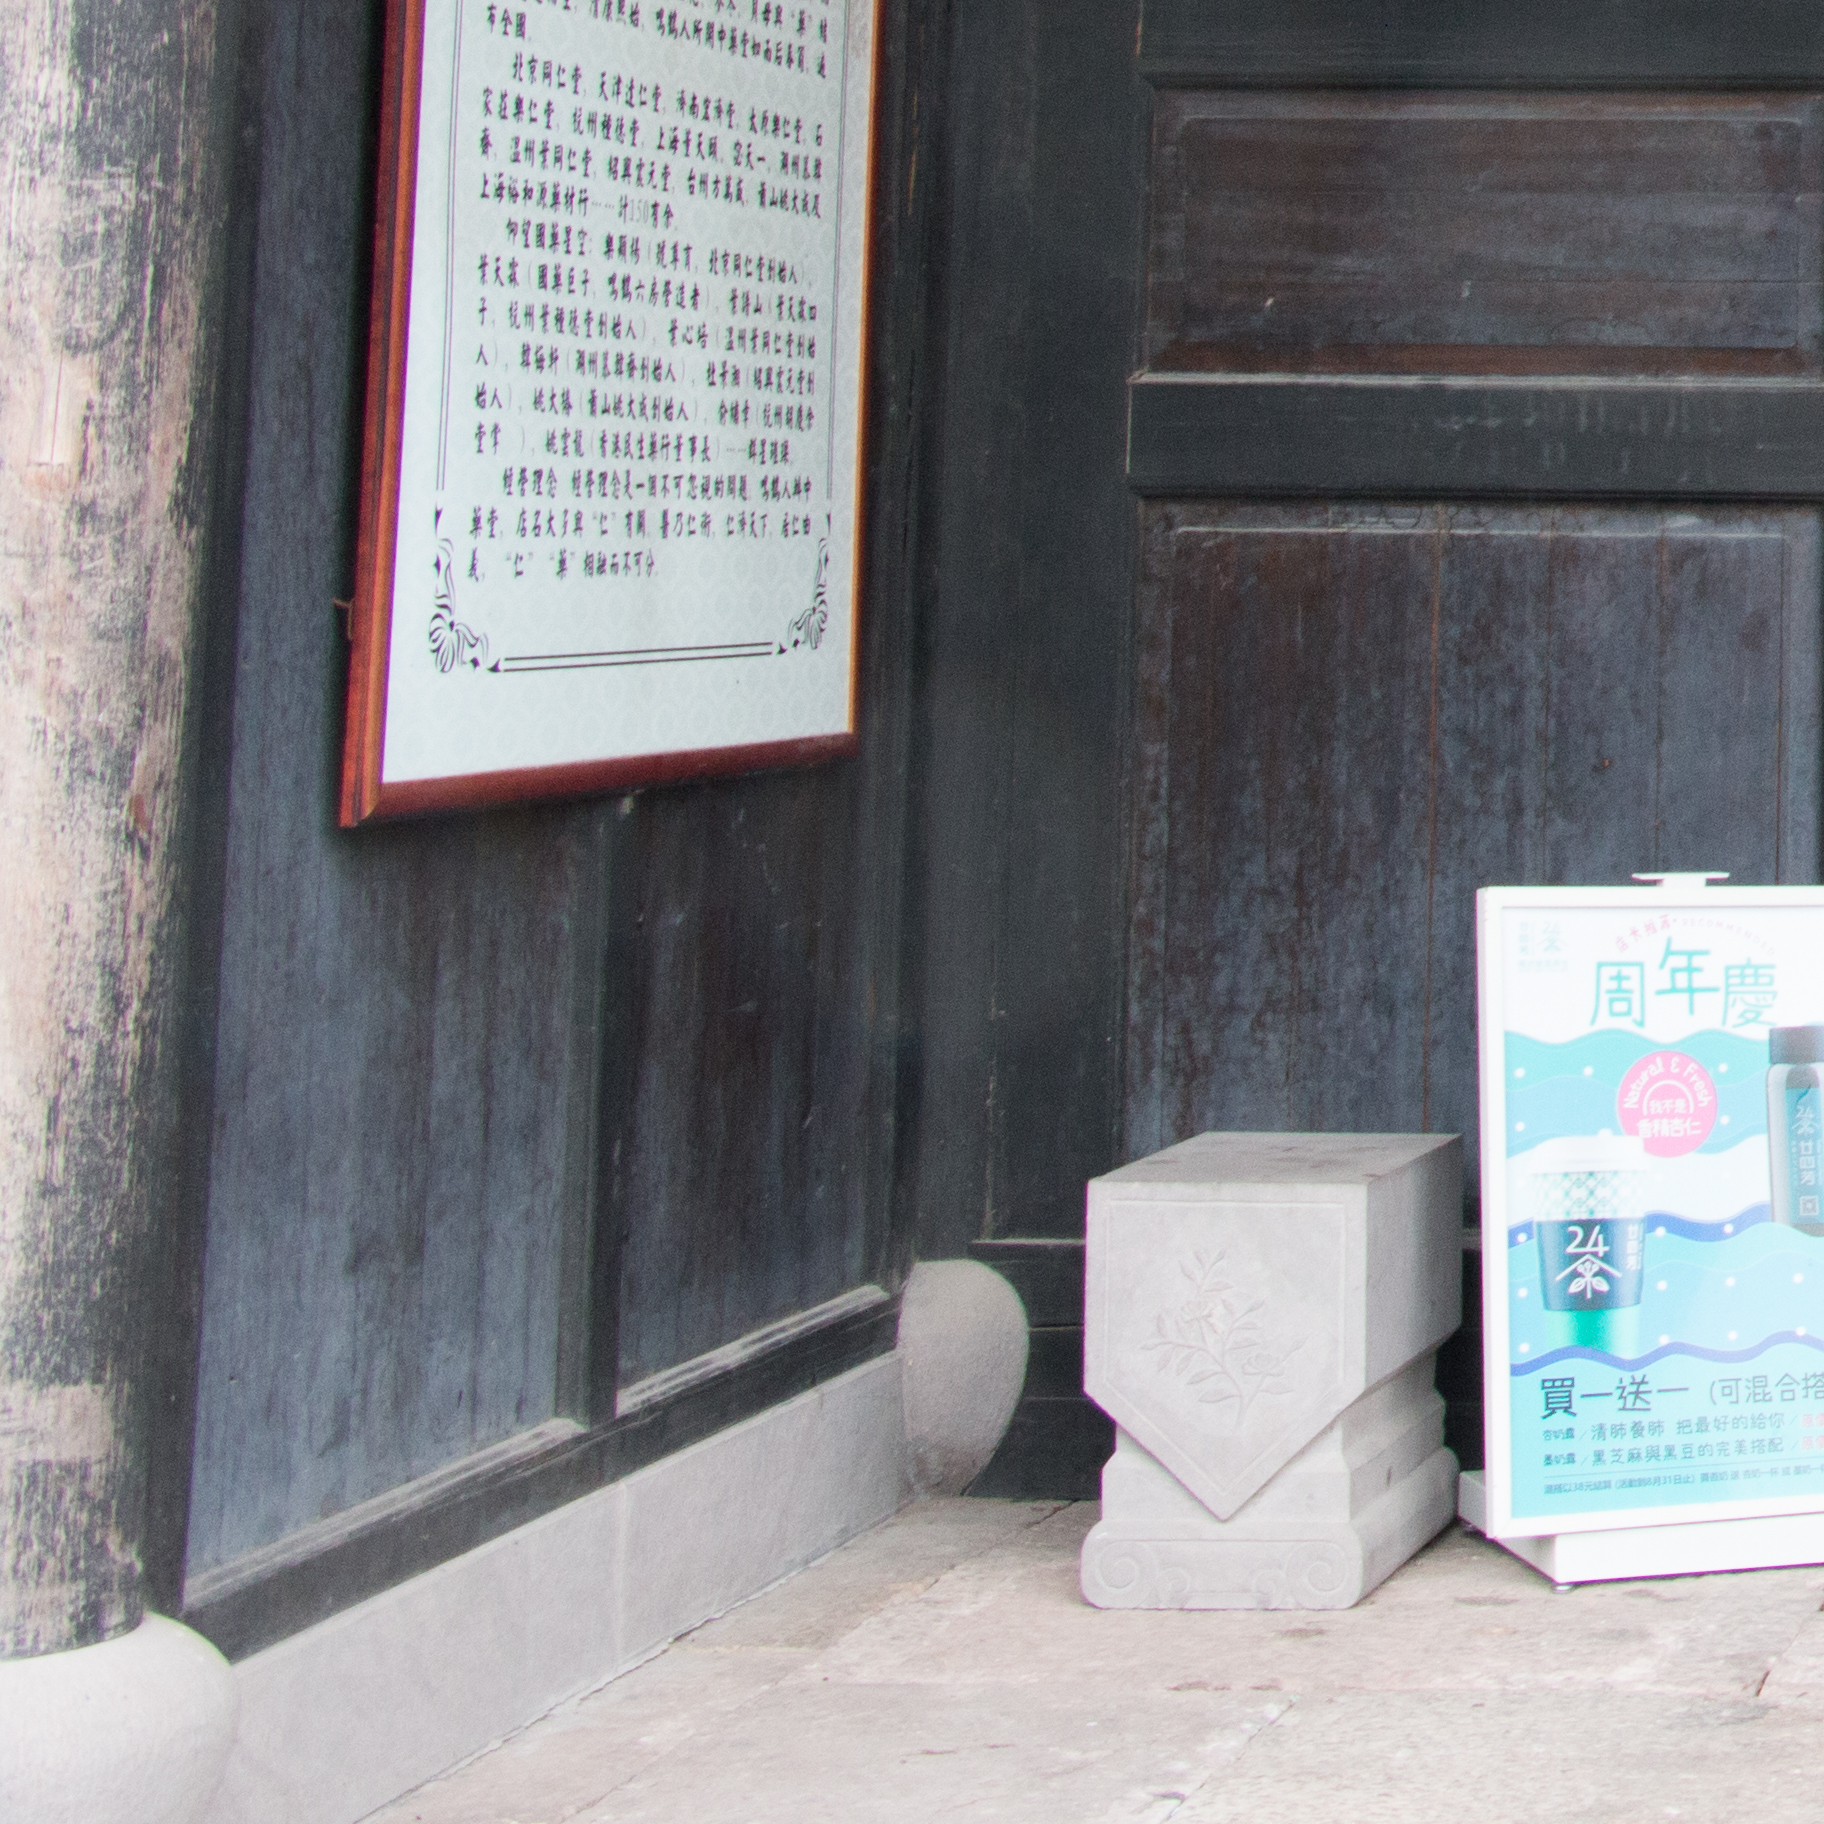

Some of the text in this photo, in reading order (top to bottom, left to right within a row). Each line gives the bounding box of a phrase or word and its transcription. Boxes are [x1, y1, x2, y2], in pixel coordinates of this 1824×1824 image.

[1590, 936, 1777, 1028] 周年慶
[1623, 1056, 1665, 1109] Natural
[1683, 1062, 1714, 1107] Fresh
[1565, 1224, 1611, 1258] 24
[1541, 1374, 1690, 1420] 買一送一
[1676, 1412, 1785, 1436] 把最好的給你
